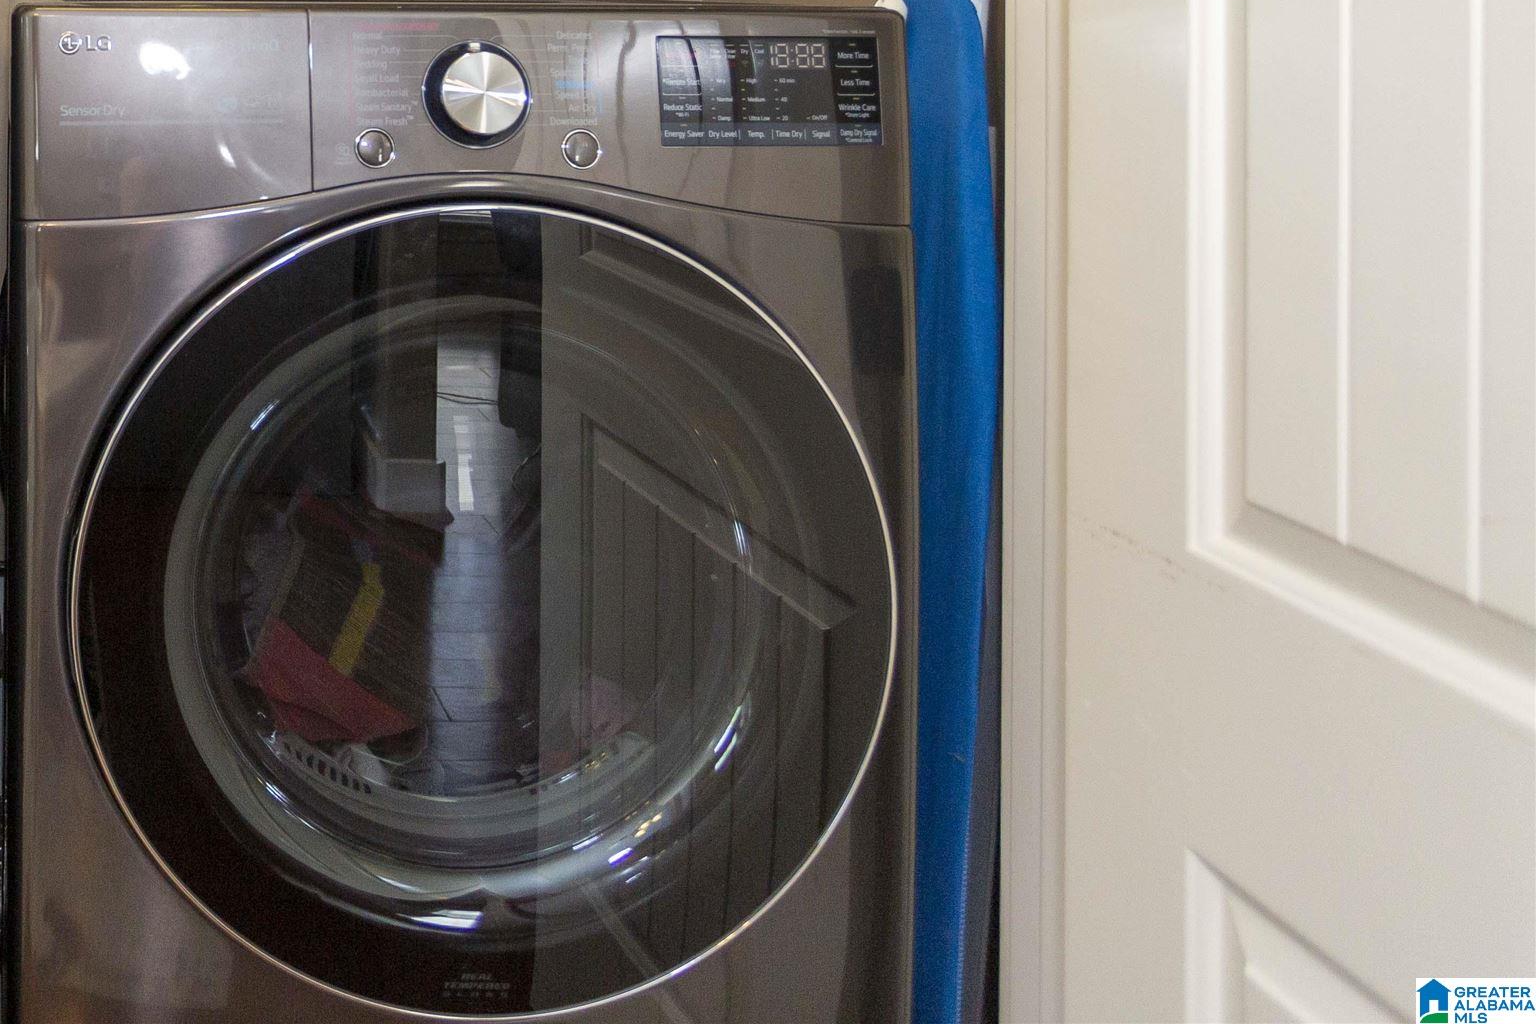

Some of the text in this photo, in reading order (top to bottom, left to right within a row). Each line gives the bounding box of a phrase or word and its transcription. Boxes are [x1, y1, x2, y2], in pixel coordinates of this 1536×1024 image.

[86, 35, 112, 51] LG
[381, 45, 401, 56] Duty
[837, 51, 870, 60] More Time
[840, 78, 871, 86] Less Time
[663, 103, 703, 111] Reduce Static
[837, 103, 876, 111] Wrinkle Care
[664, 129, 705, 139] Energy Saver
[708, 129, 738, 139] Dry Level
[775, 129, 803, 138] Time Dry
[811, 129, 831, 139] Signal
[863, 128, 878, 138] Signal
